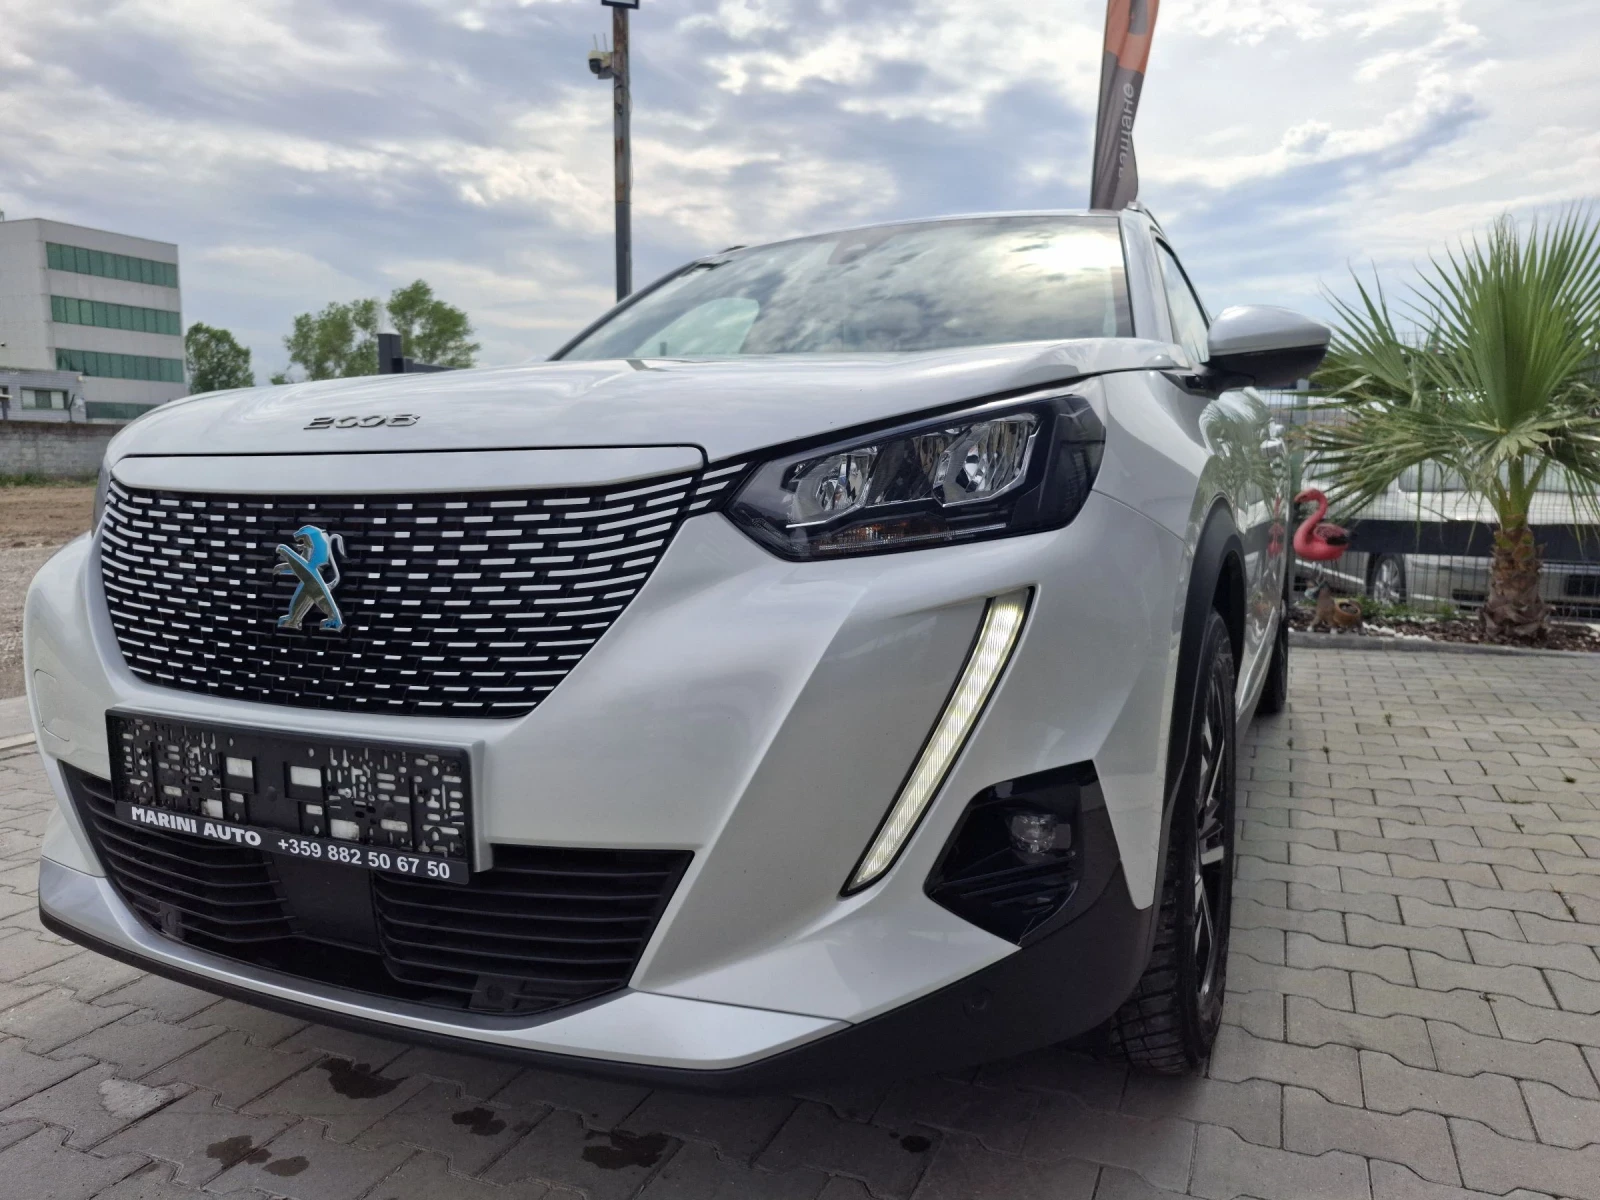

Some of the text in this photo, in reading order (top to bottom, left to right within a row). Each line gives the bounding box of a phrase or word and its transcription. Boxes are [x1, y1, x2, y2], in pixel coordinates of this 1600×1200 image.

[303, 414, 420, 430] 2008
[131, 806, 451, 879] MARINI AUTO +359 882 50 67 50
